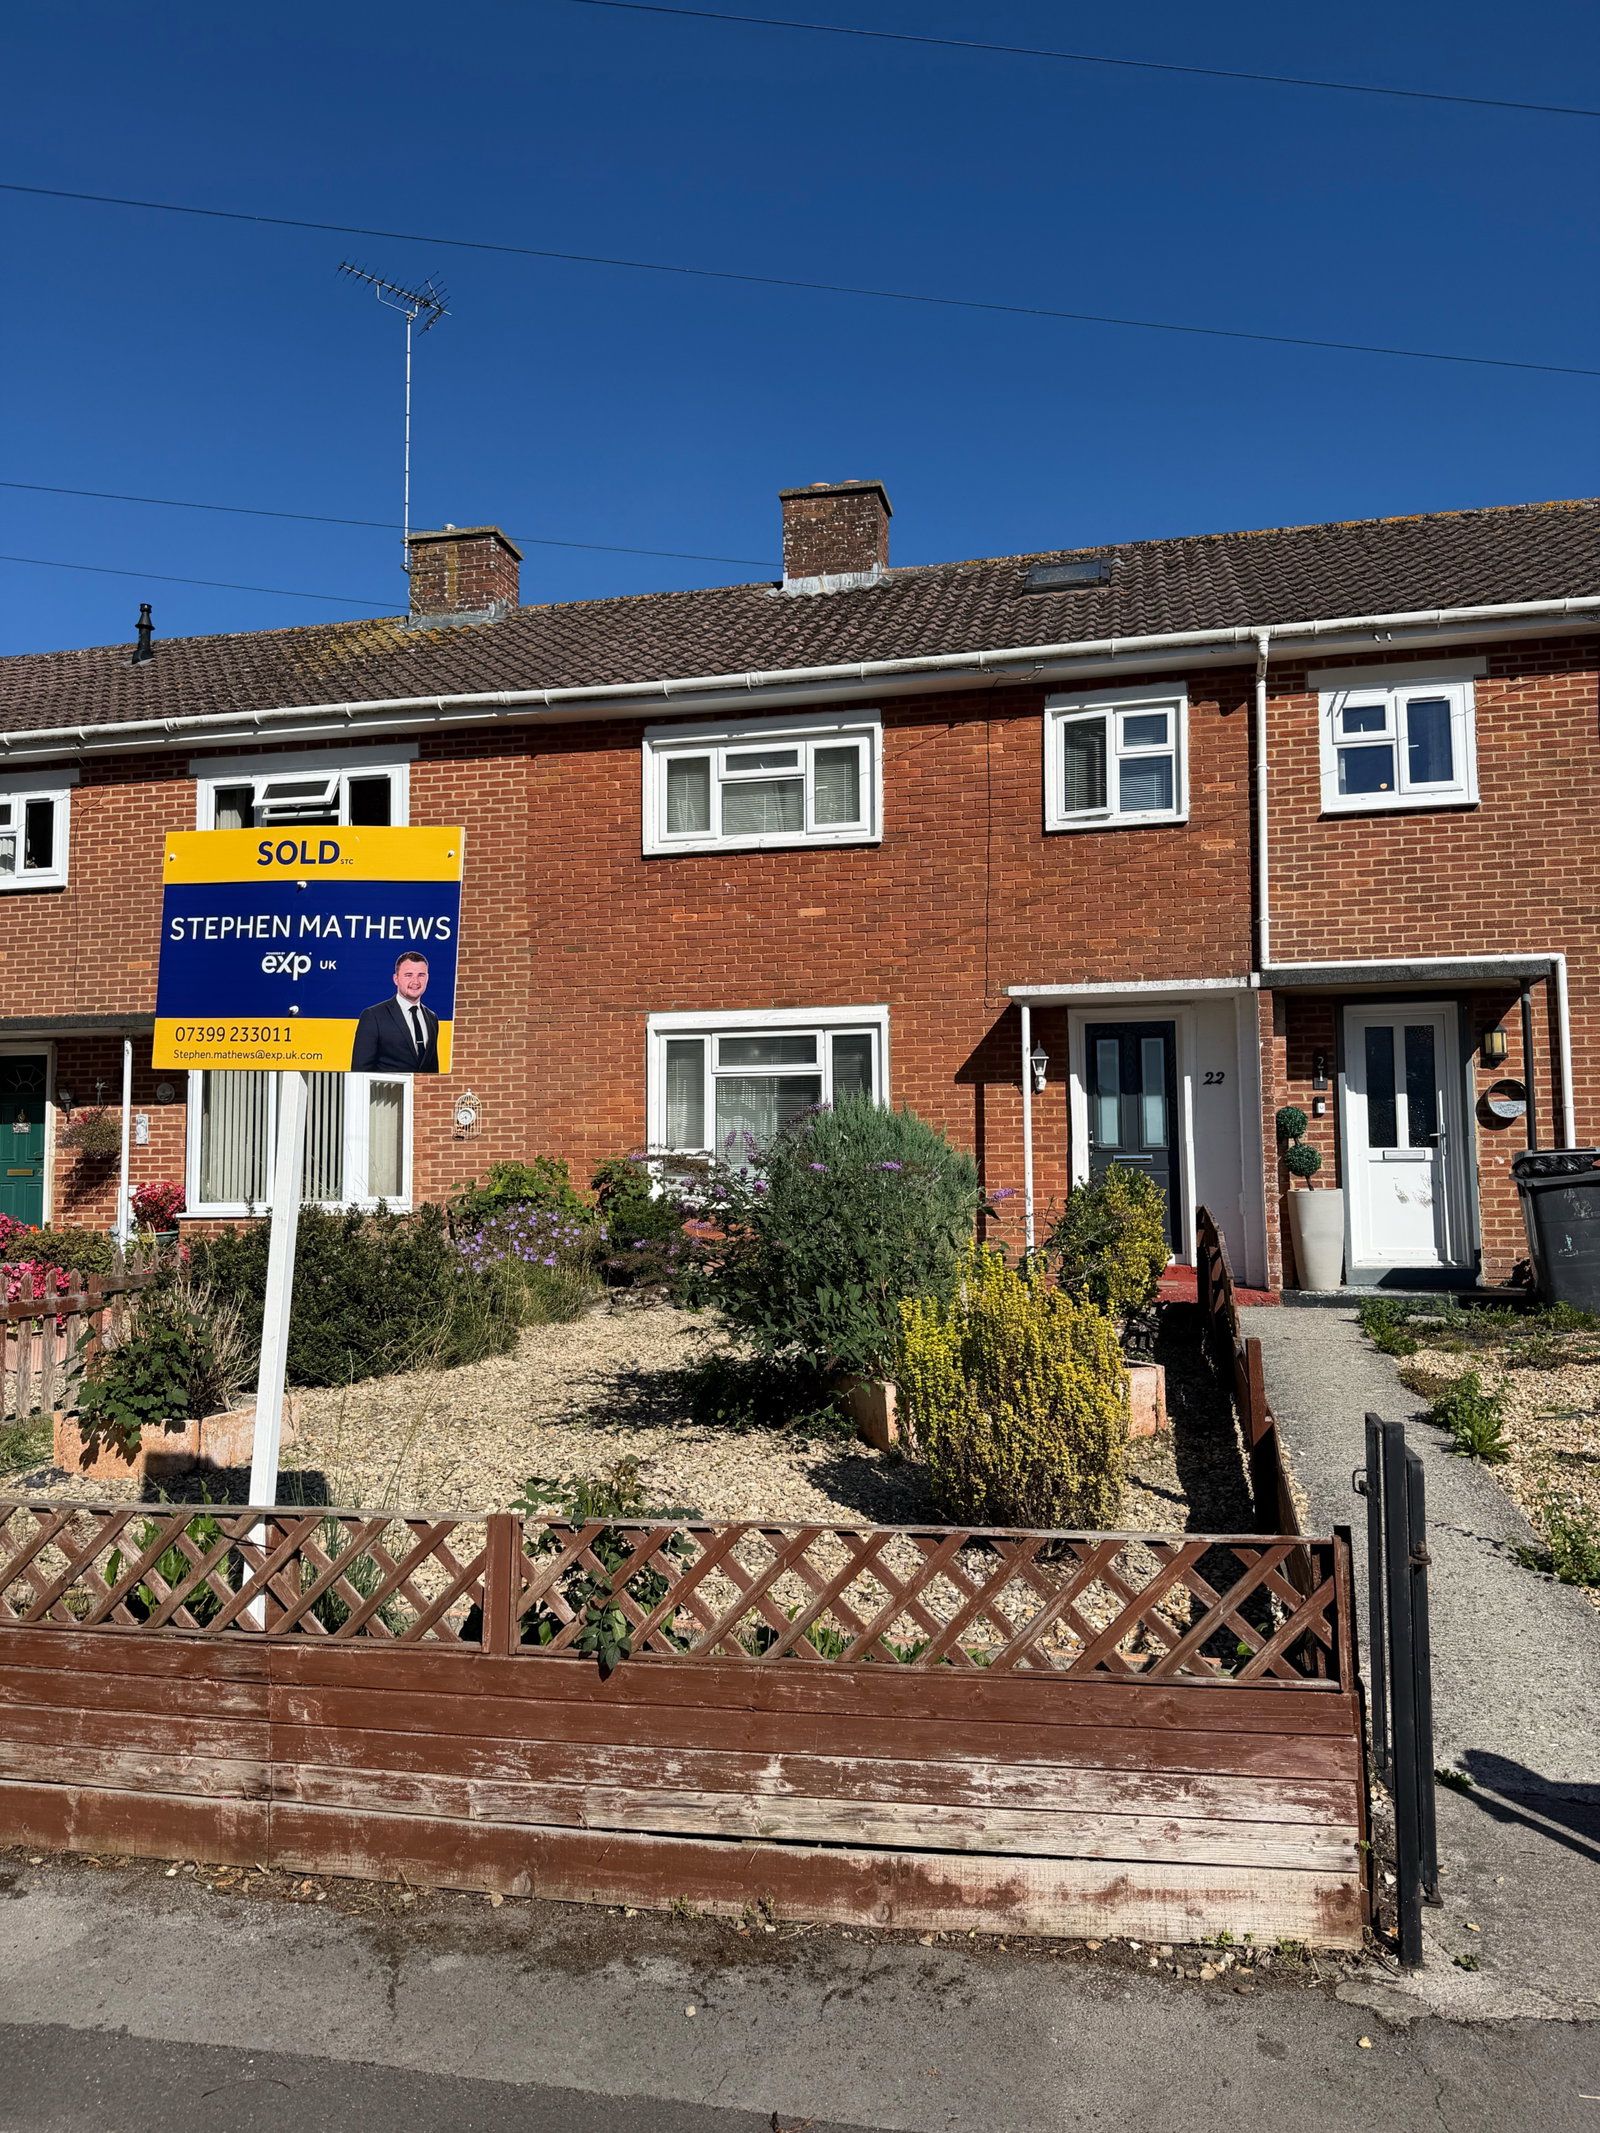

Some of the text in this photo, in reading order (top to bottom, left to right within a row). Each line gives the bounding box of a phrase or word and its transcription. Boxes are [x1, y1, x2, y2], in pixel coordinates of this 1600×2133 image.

[257, 840, 340, 866] SOLD
[169, 914, 451, 940] STEPHEN MATHEWS
[319, 960, 337, 970] UK
[175, 1026, 292, 1042] 07399 233011
[173, 1049, 323, 1061] Stephen.mathews@exp.uk.com
[1202, 1071, 1225, 1085] 22
